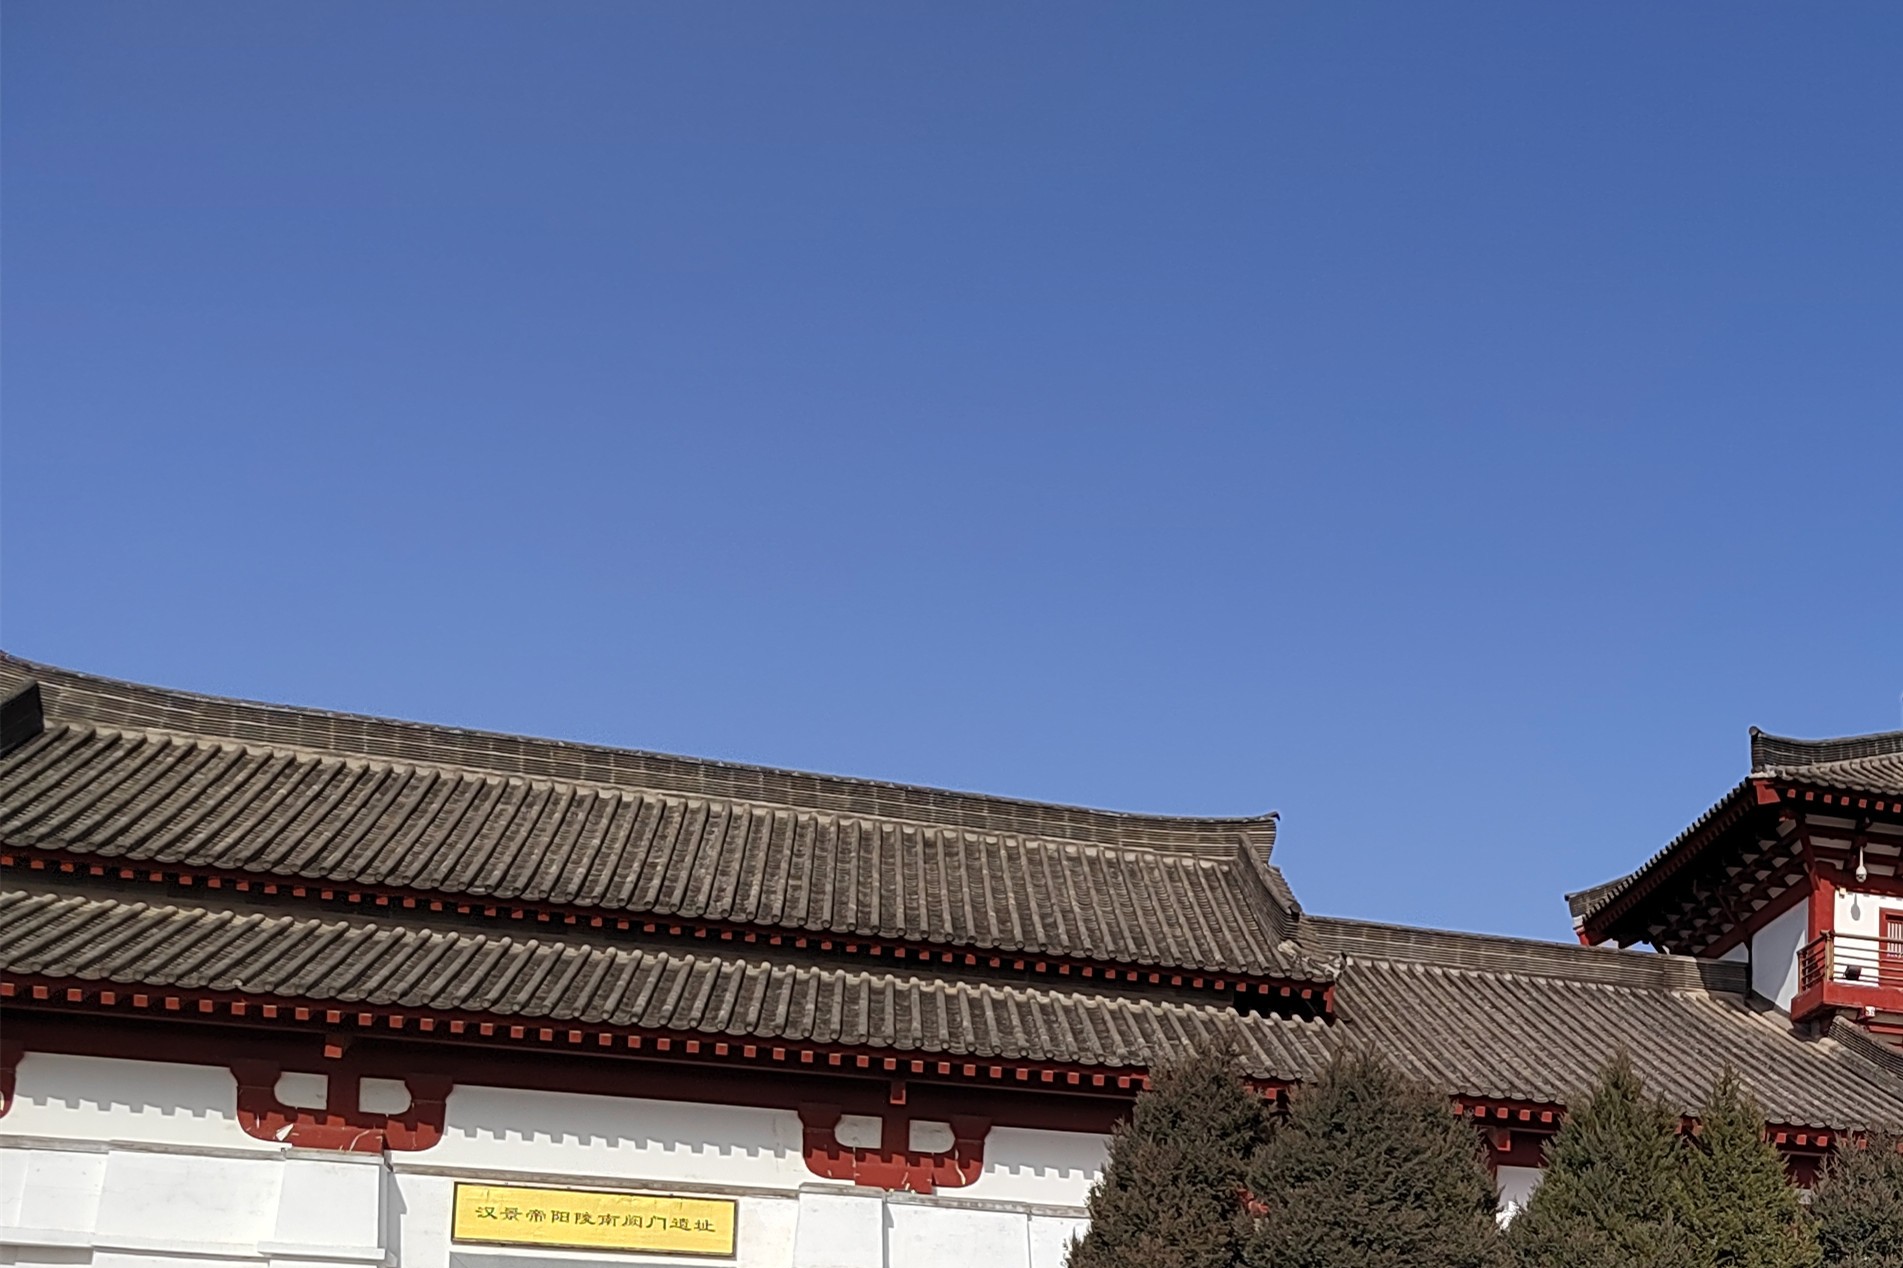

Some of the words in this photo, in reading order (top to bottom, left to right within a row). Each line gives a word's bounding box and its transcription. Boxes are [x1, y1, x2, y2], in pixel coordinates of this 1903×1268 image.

[474, 1205, 717, 1233] 汉景帝阳陵南阙门遗址
